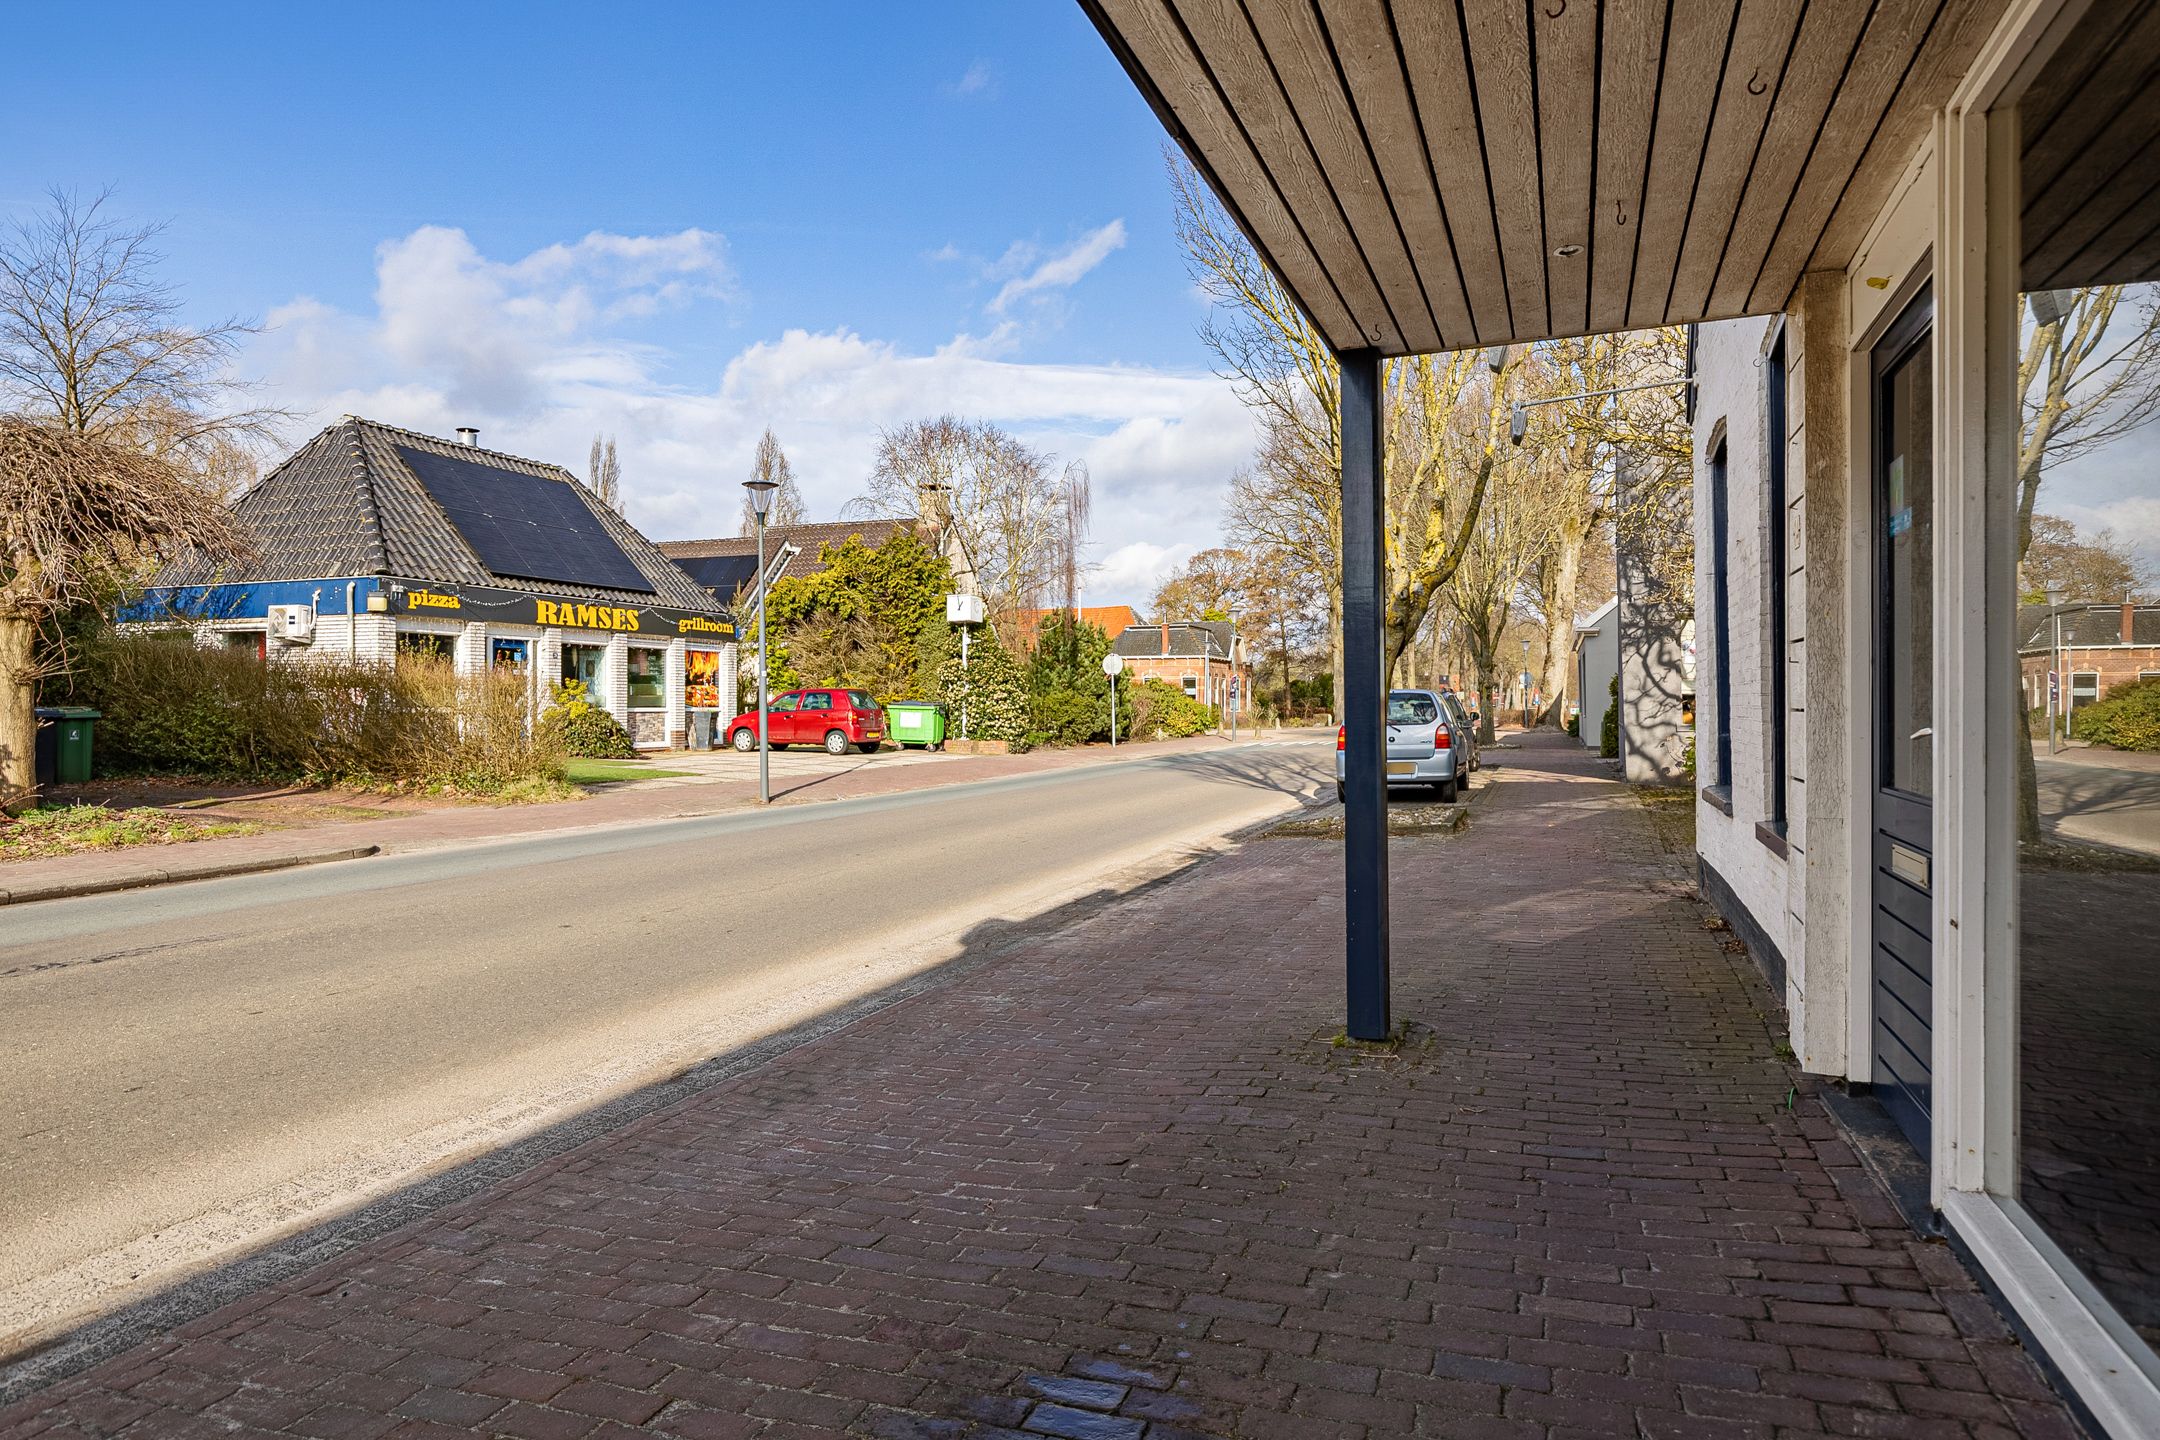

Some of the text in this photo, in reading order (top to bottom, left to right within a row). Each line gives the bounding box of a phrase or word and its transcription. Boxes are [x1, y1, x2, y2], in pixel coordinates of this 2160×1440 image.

[408, 589, 461, 609] pizza
[536, 600, 640, 631] RAMSES
[679, 617, 734, 634] grillroom
